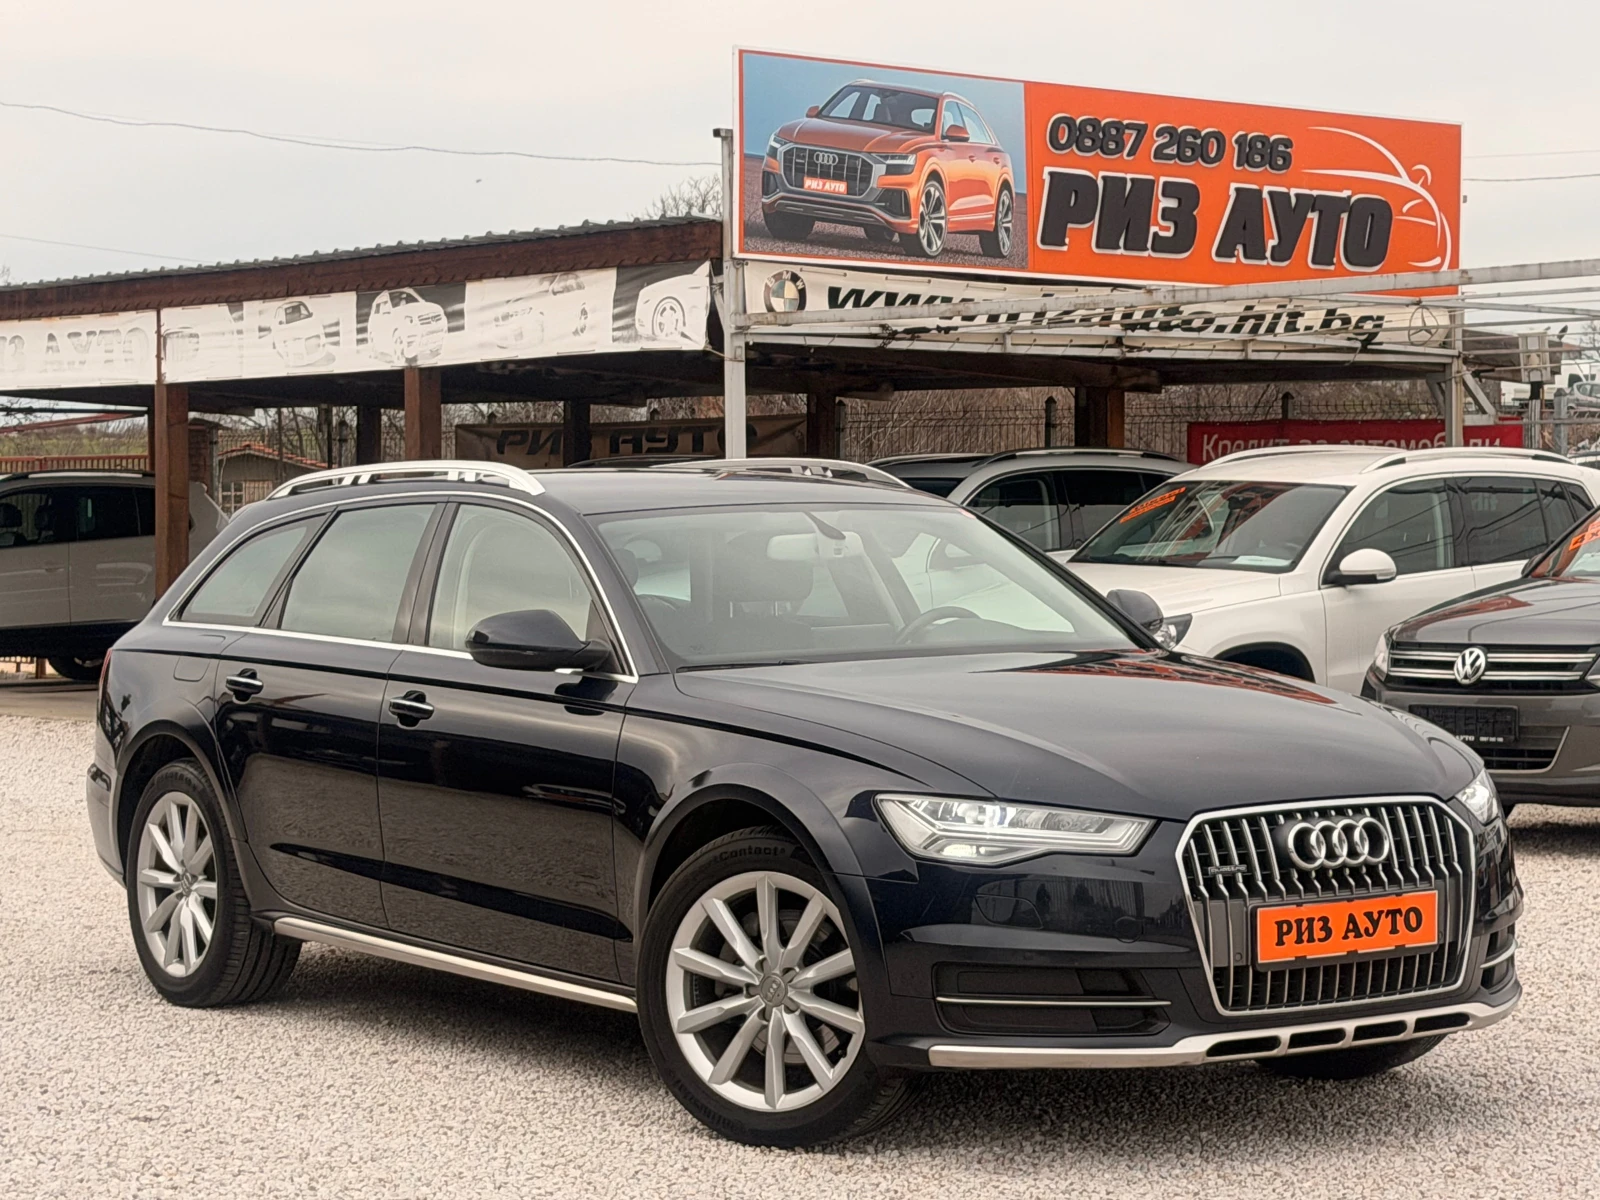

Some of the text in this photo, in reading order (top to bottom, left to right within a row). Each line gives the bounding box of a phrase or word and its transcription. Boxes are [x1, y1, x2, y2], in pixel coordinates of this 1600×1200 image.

[1047, 113, 1293, 172] 0887 260 186
[1037, 166, 1393, 273] РИЗ АУТО
[1274, 906, 1423, 946] РИЗ АУТО
